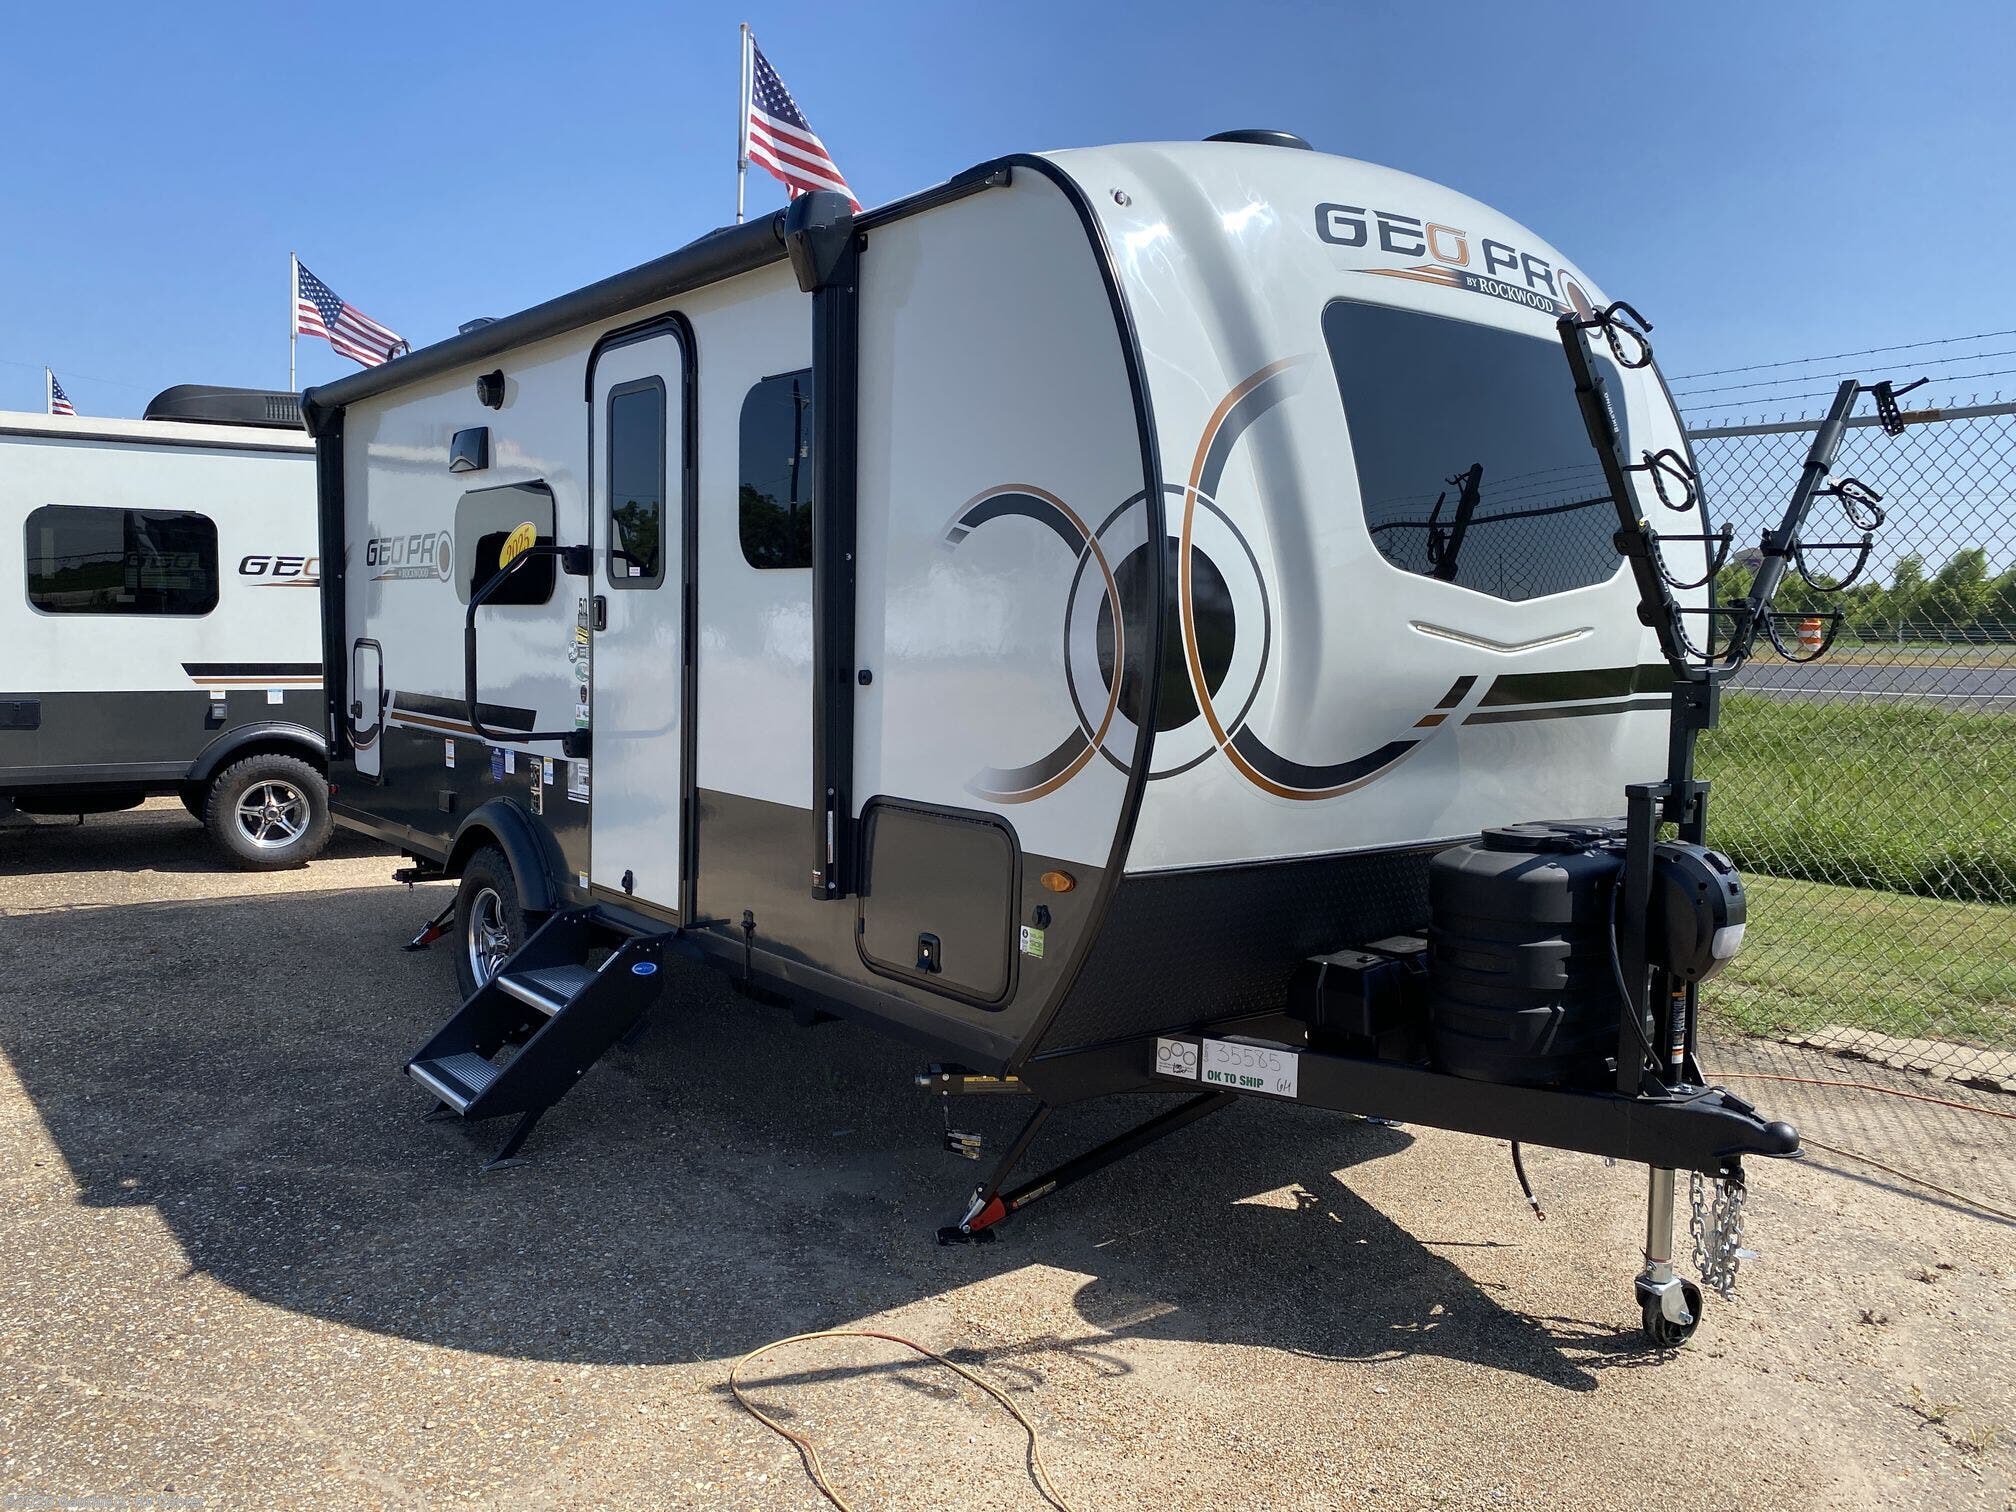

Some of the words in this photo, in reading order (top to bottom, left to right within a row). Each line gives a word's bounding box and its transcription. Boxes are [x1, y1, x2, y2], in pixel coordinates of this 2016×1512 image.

[1313, 201, 1471, 268] GEO
[1481, 237, 1602, 339] PRO
[1466, 276, 1478, 288] BY
[1479, 277, 1554, 314] ROCKWOOD
[366, 536, 404, 567] GEO
[406, 530, 454, 583] PRO
[1207, 1069, 1222, 1082] OK
[1224, 1072, 1237, 1084] TO
[1239, 1075, 1264, 1088] SHIP
